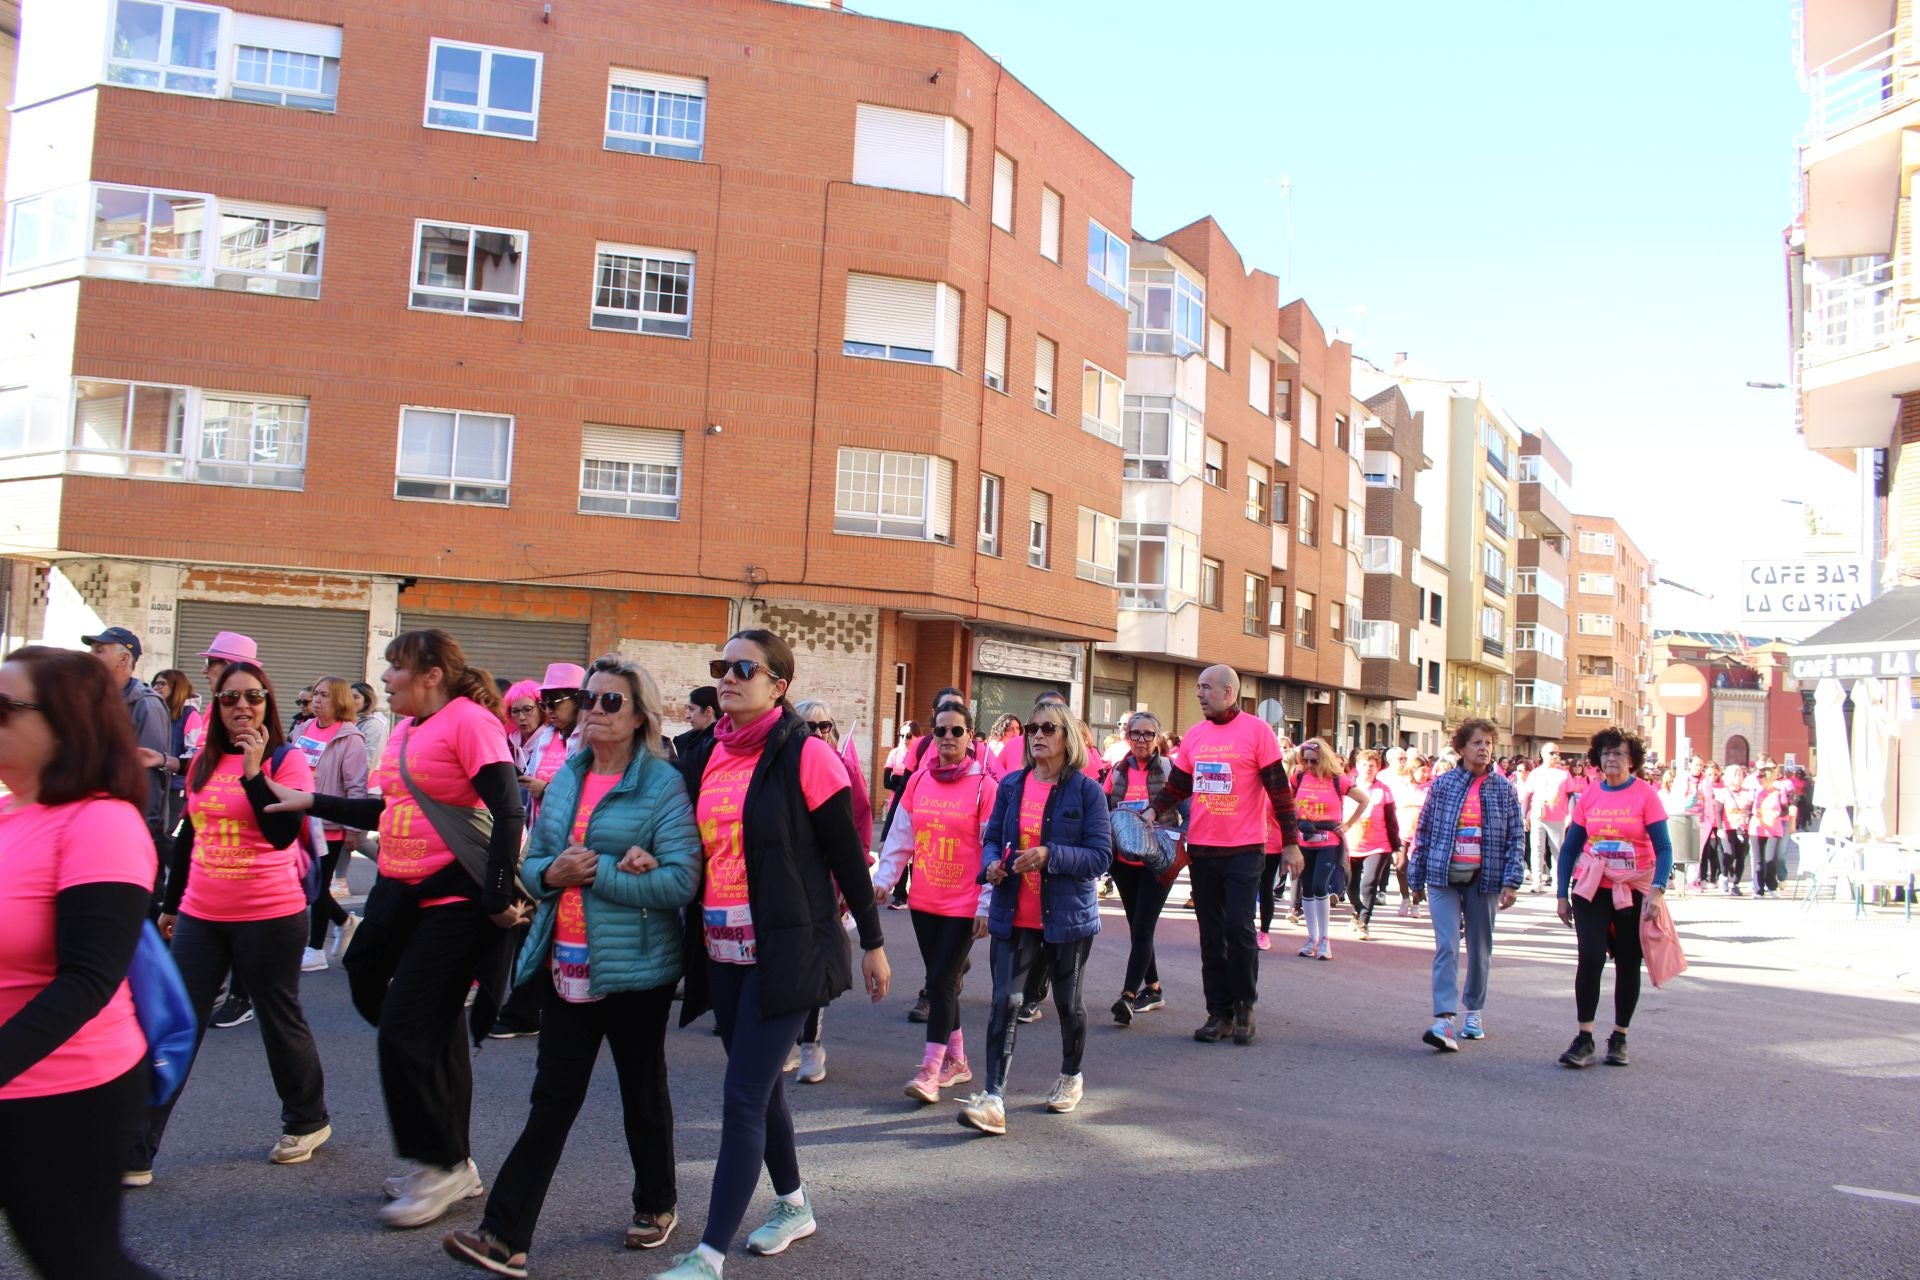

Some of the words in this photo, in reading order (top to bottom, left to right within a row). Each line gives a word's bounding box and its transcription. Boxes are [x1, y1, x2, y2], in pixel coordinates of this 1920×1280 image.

[1751, 566, 1805, 584] CAFE
[1817, 565, 1859, 583] BAR
[1746, 594, 1771, 612] LA
[1836, 657, 1873, 676] BAR
[1881, 651, 1911, 675] LA
